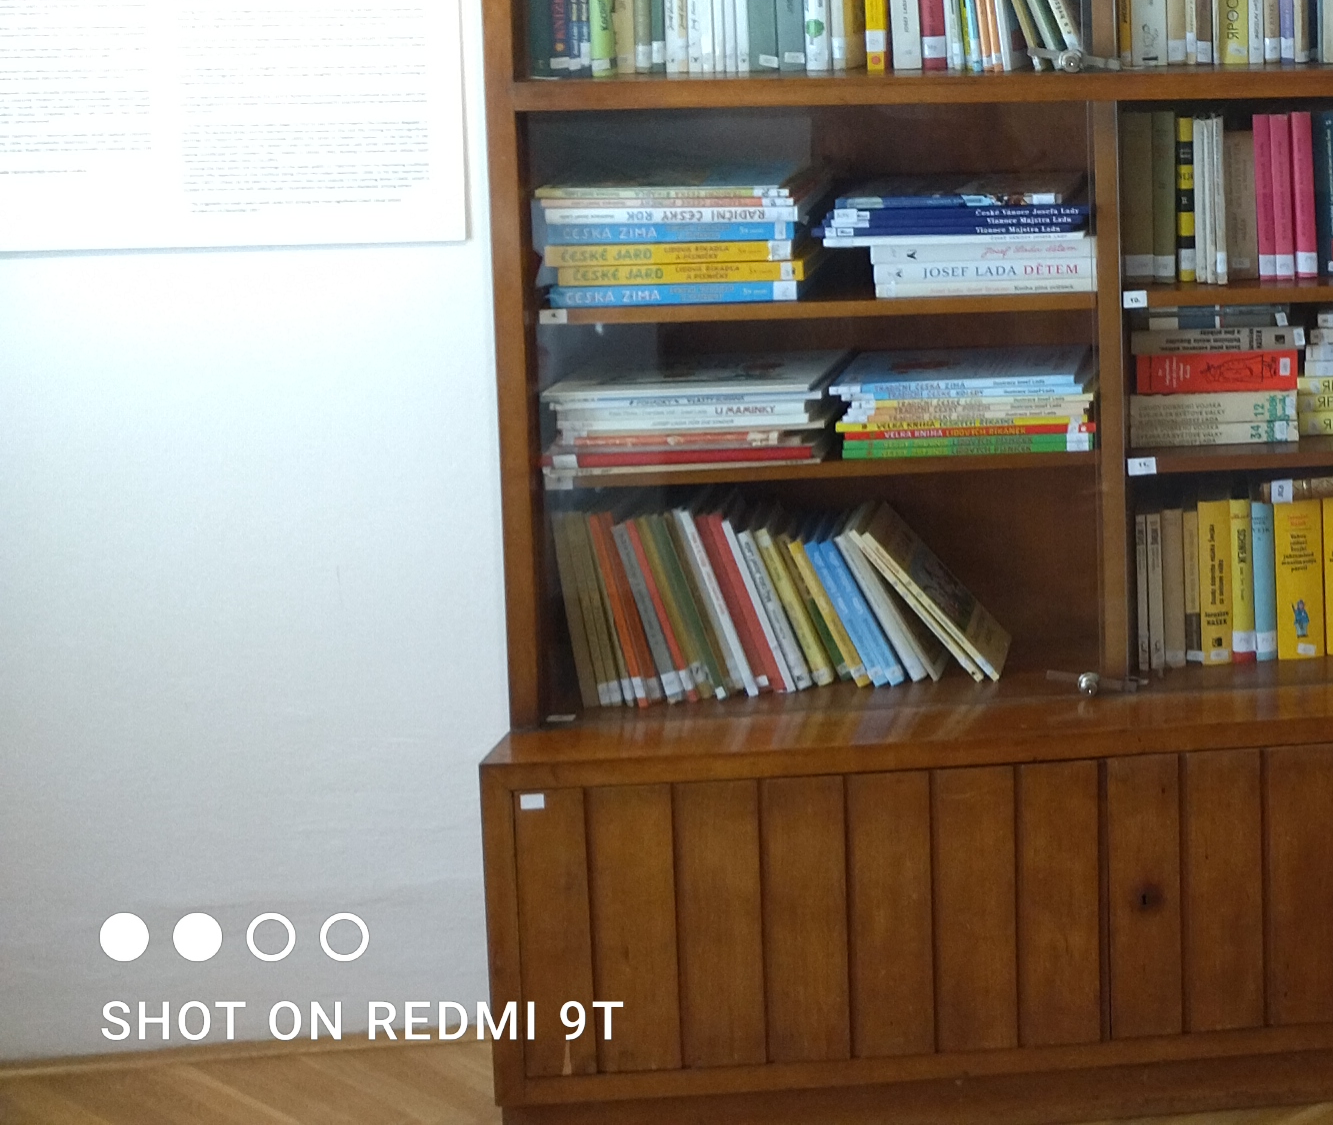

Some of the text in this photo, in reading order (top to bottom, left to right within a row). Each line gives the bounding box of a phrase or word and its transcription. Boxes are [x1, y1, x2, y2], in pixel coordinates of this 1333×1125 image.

[626, 212, 653, 221] ROK
[1060, 208, 1079, 217] Lady
[619, 228, 657, 238] ZIMA
[561, 248, 652, 262] ČESKÉ JARO
[625, 268, 664, 280] JARO
[923, 262, 1079, 279] JOSEF LADA DĚTEM
[622, 290, 661, 302] ZIMA
[715, 407, 723, 415] U
[725, 405, 776, 415] MAMINKY
[1254, 403, 1265, 417] 12
[914, 430, 942, 438] KNIHA
[1251, 425, 1262, 439] 34
